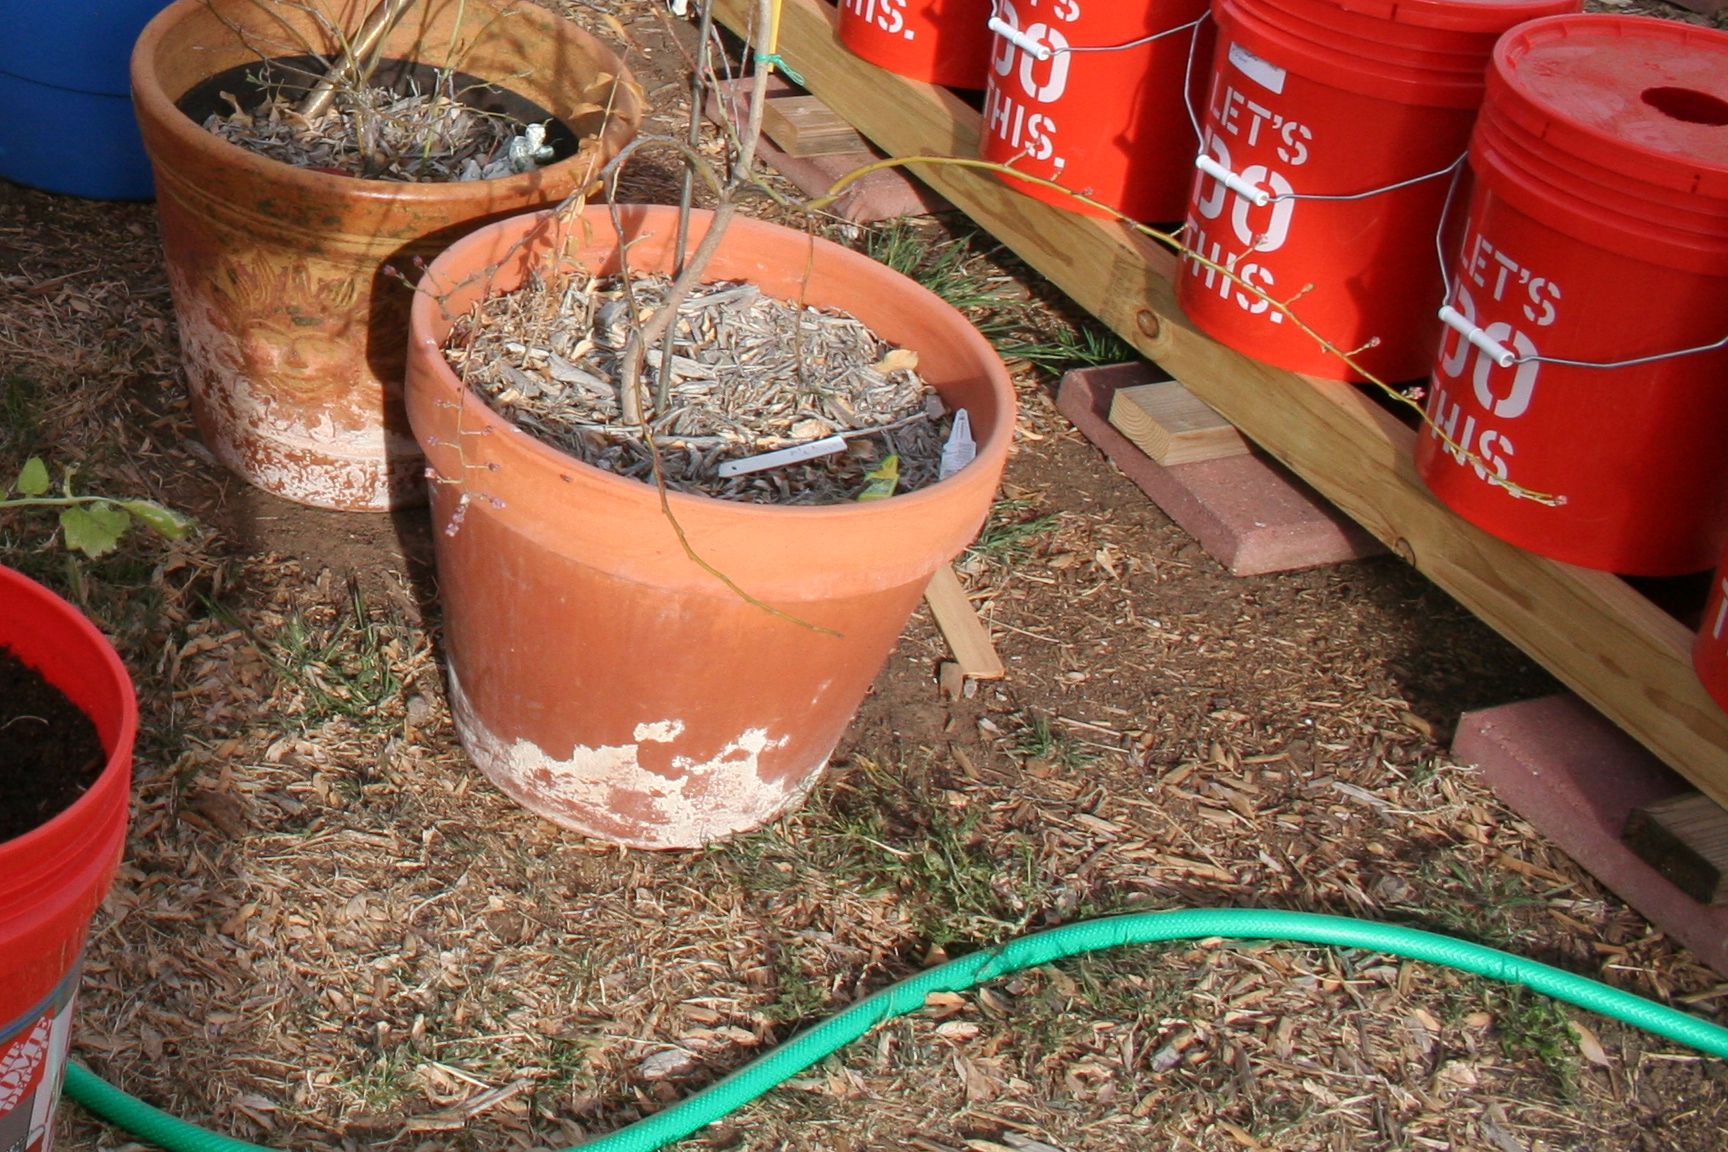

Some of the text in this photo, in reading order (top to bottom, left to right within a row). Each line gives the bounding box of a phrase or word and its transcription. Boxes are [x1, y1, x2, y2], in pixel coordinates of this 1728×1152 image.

[1210, 70, 1312, 166] LET'S
[1194, 123, 1295, 252] DO
[1182, 211, 1284, 324] THIS.
[1459, 216, 1561, 326] LET'S
[1437, 273, 1540, 419] DO
